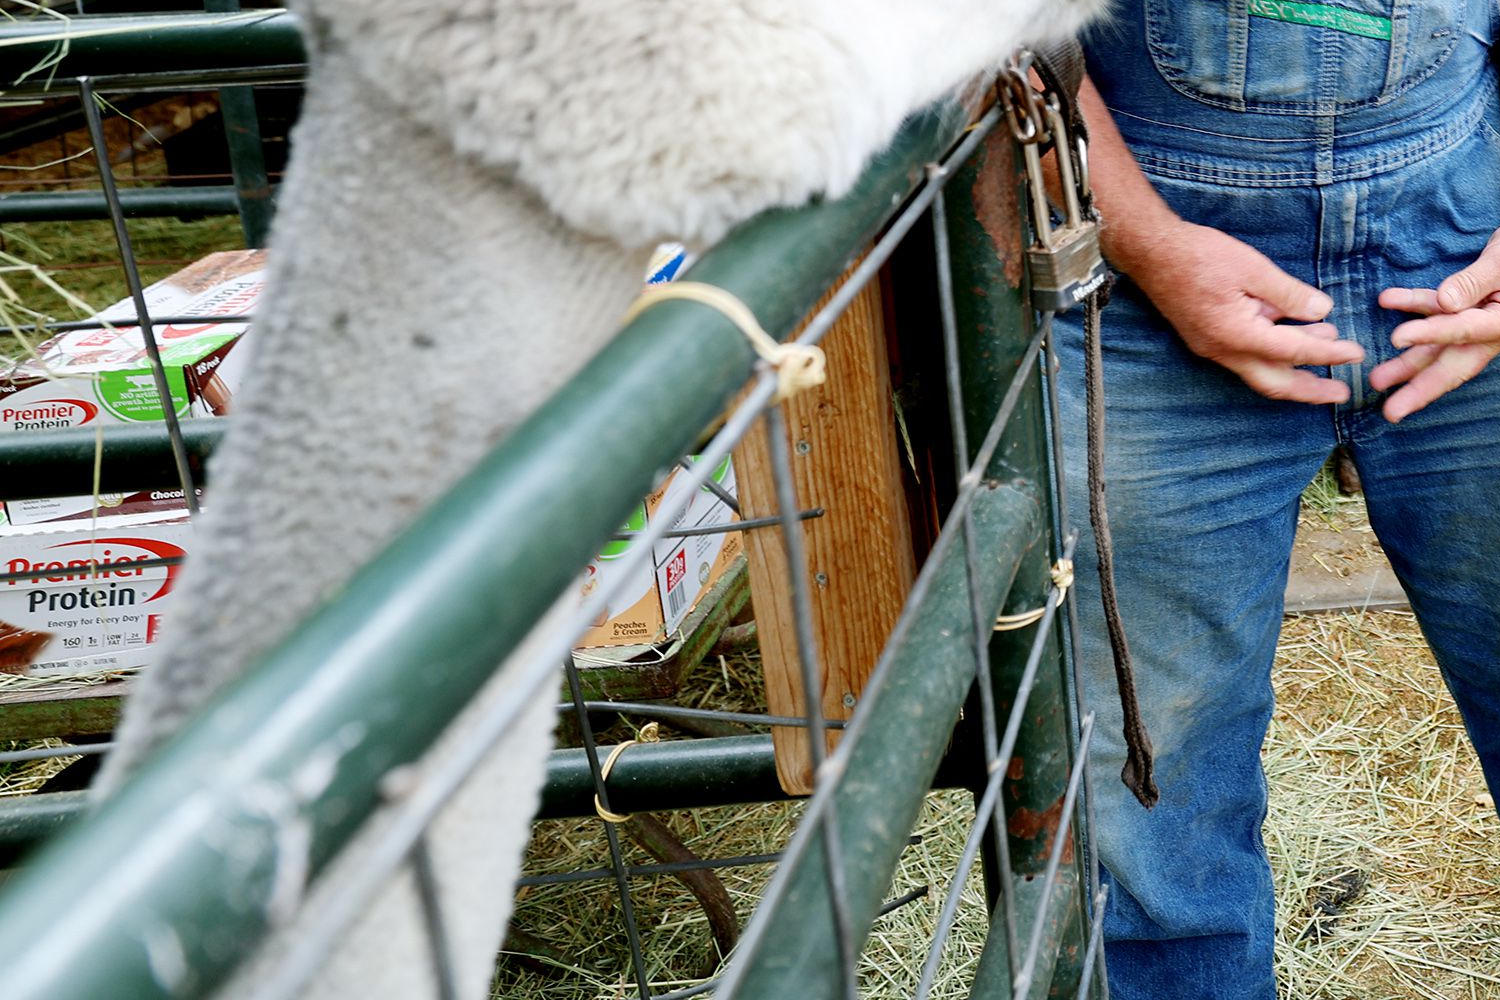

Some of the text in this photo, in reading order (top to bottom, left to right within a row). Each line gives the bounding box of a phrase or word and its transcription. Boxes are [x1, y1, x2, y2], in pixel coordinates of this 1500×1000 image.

[3, 404, 75, 422] Premier
[150, 488, 202, 500] Chocole
[5, 550, 148, 586] Premier
[27, 582, 135, 613] Protein
[47, 613, 141, 629] Energy for Every Day
[613, 621, 646, 630] Peaches
[621, 628, 648, 636] Cream
[62, 637, 81, 647] 160
